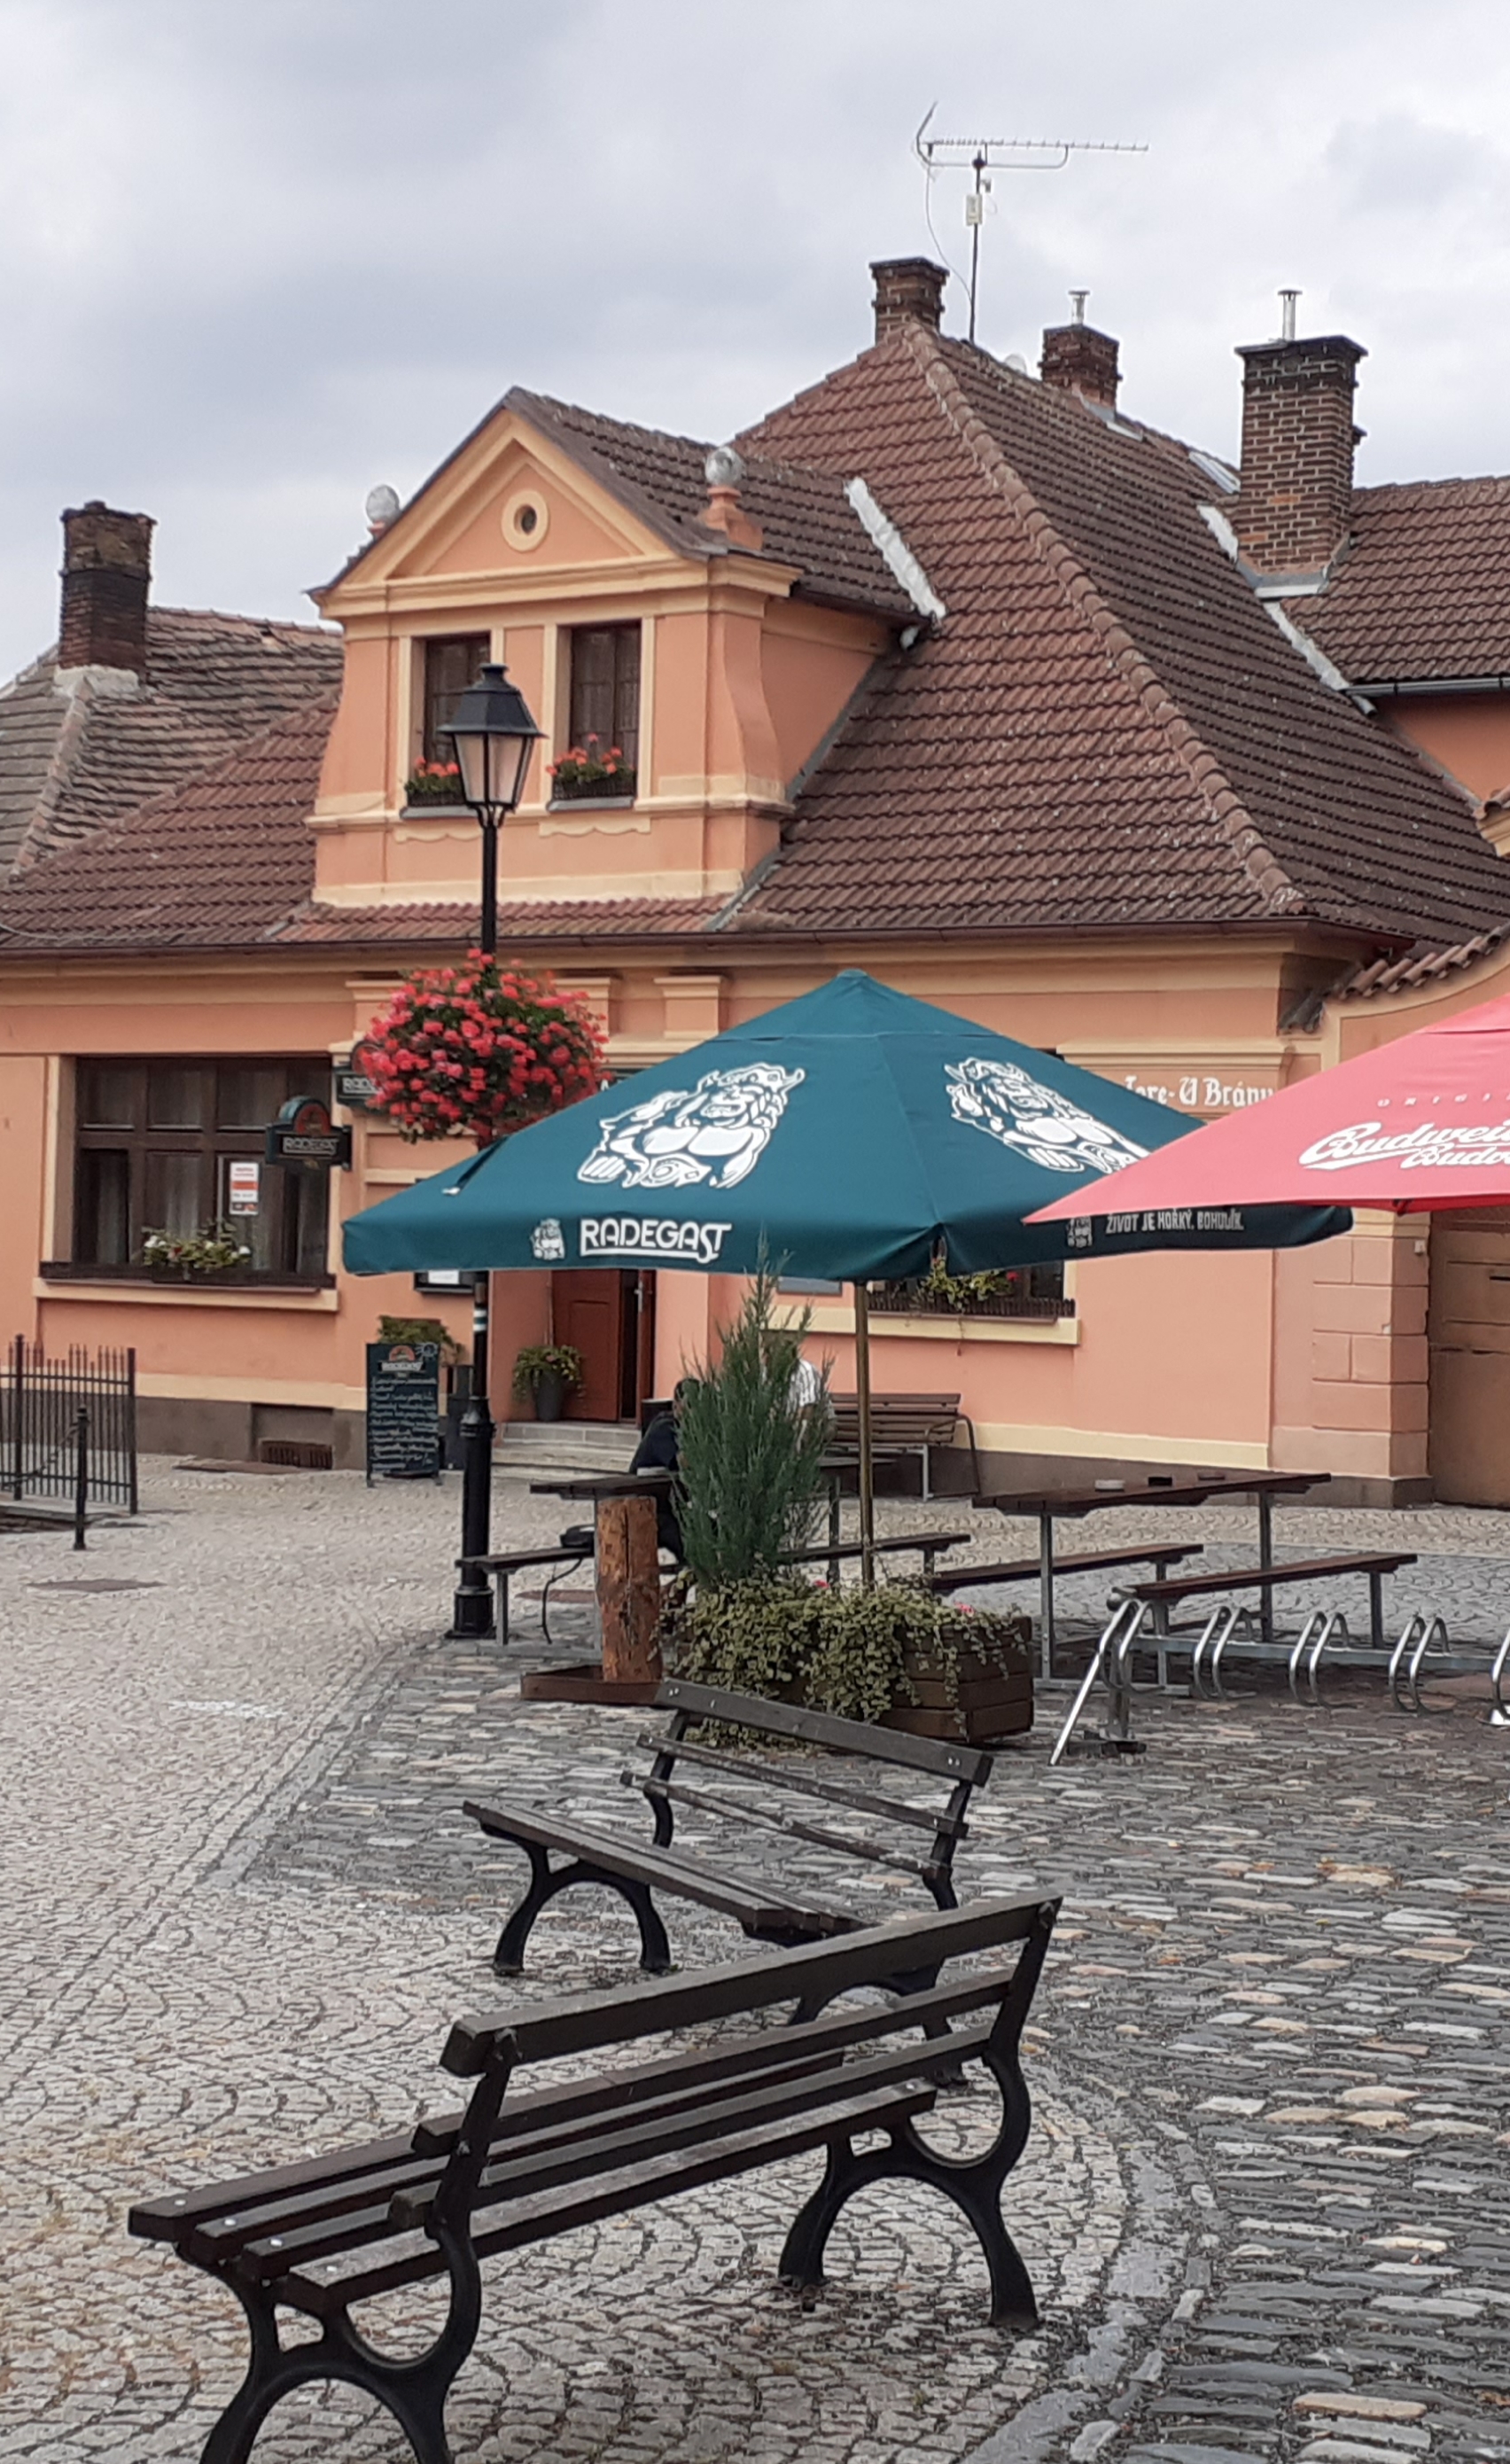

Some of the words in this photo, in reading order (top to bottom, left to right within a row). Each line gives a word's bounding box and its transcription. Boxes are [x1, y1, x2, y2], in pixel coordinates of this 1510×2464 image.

[1377, 1092, 1510, 1107] ORIGI
[1141, 1212, 1156, 1231] JE
[580, 1219, 732, 1264] RADEGAST
